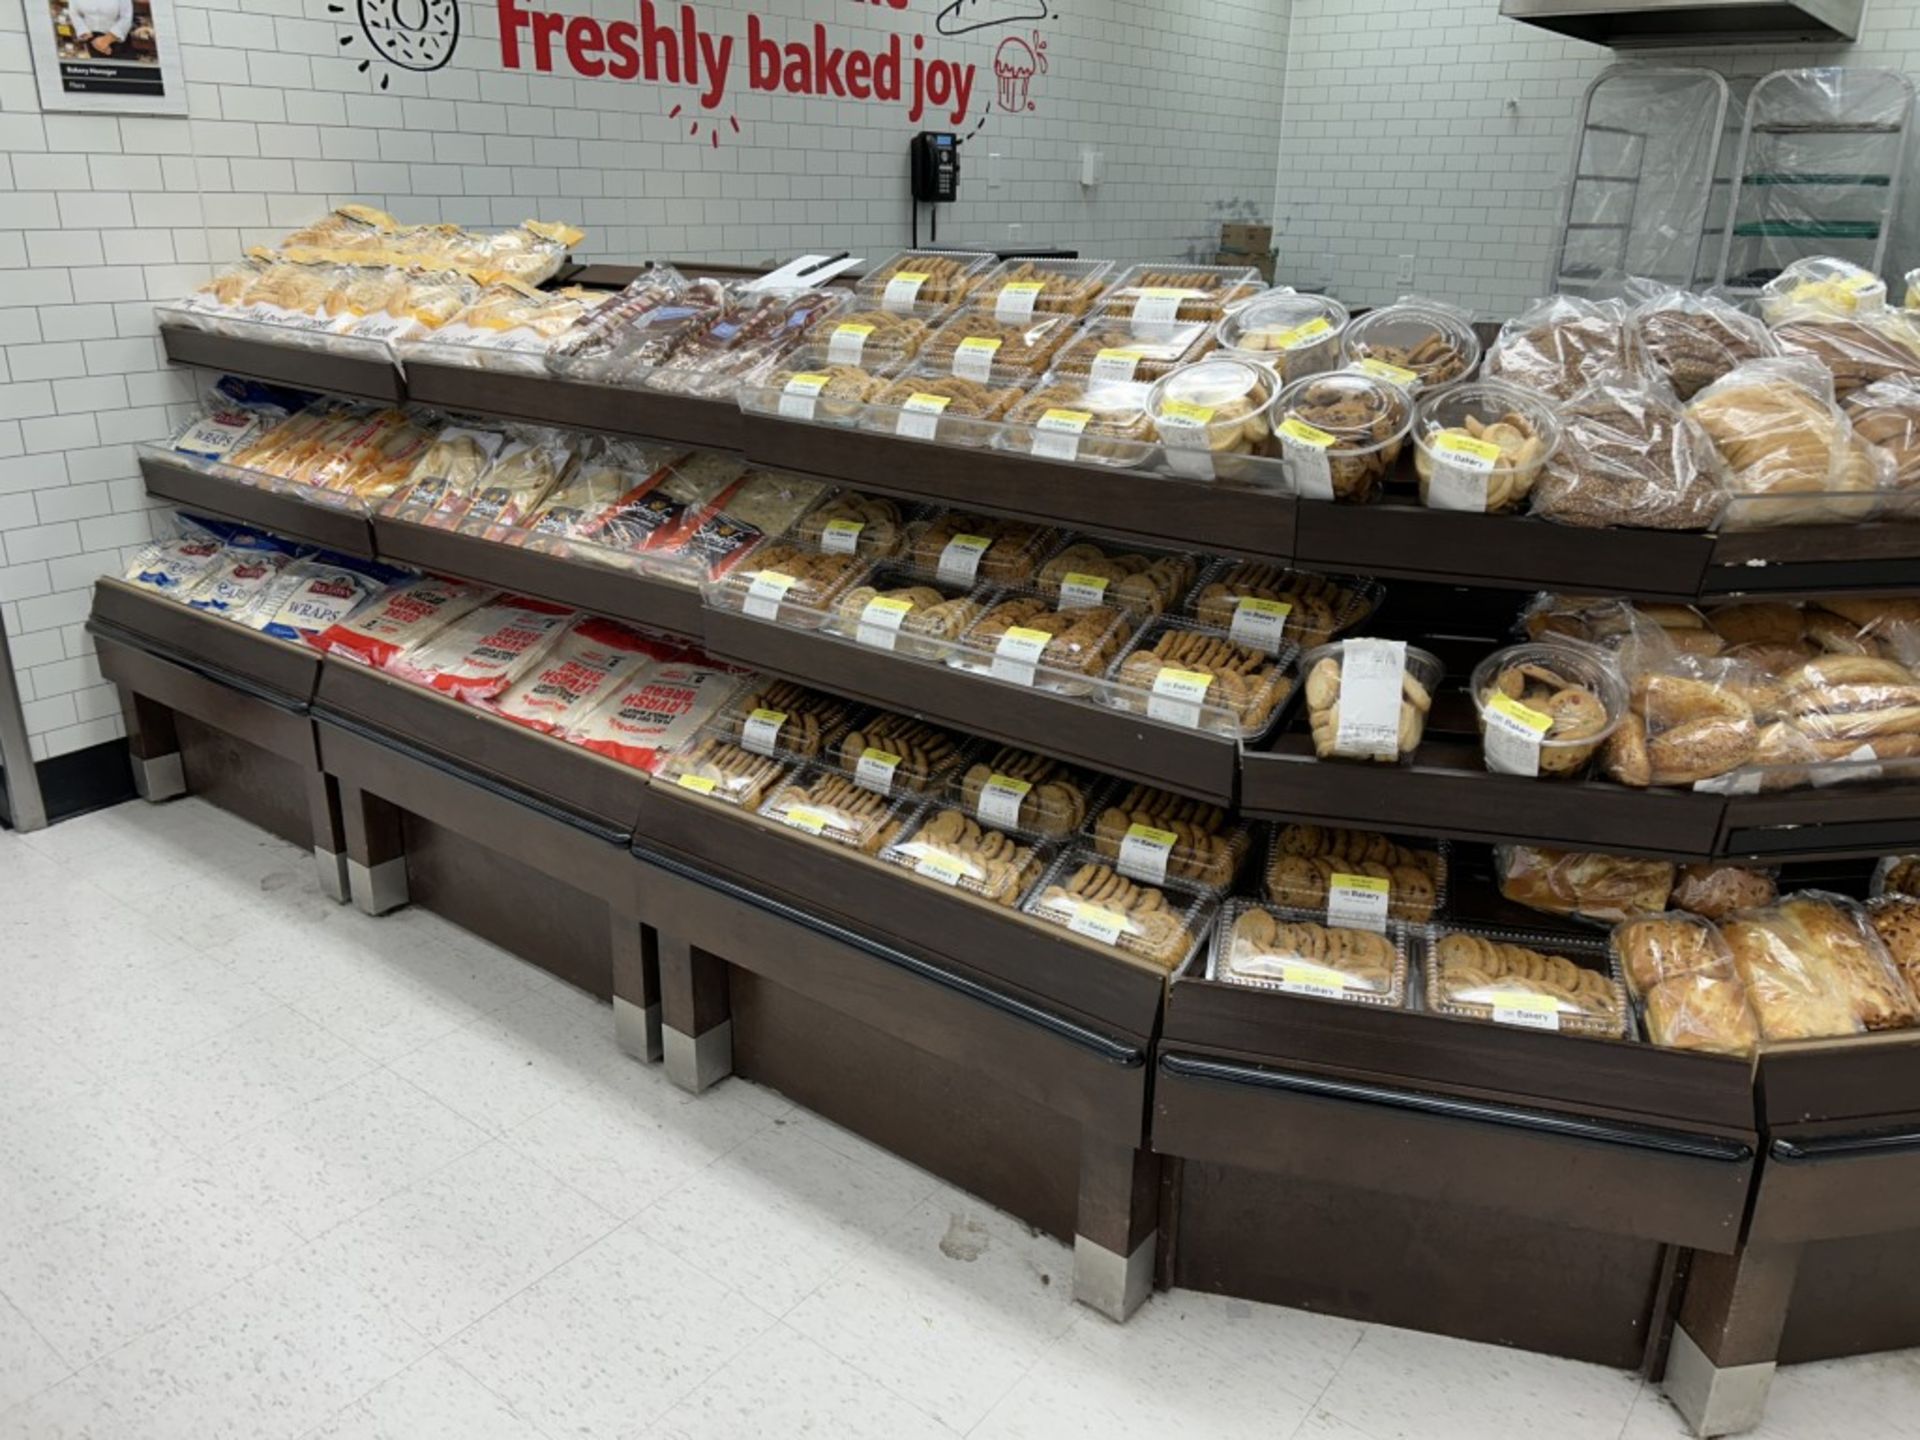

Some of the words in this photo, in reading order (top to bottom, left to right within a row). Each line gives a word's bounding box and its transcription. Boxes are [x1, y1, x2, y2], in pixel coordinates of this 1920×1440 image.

[496, 0, 733, 109] Freshly
[748, 14, 900, 101] baked
[908, 34, 976, 126] joy
[288, 601, 341, 621] WRAPS
[641, 684, 697, 701] BREAD
[621, 692, 694, 715] LAVASH
[1351, 890, 1379, 901] Bakery
[1305, 985, 1334, 996] Bakery
[1517, 1010, 1549, 1022] Bakery
